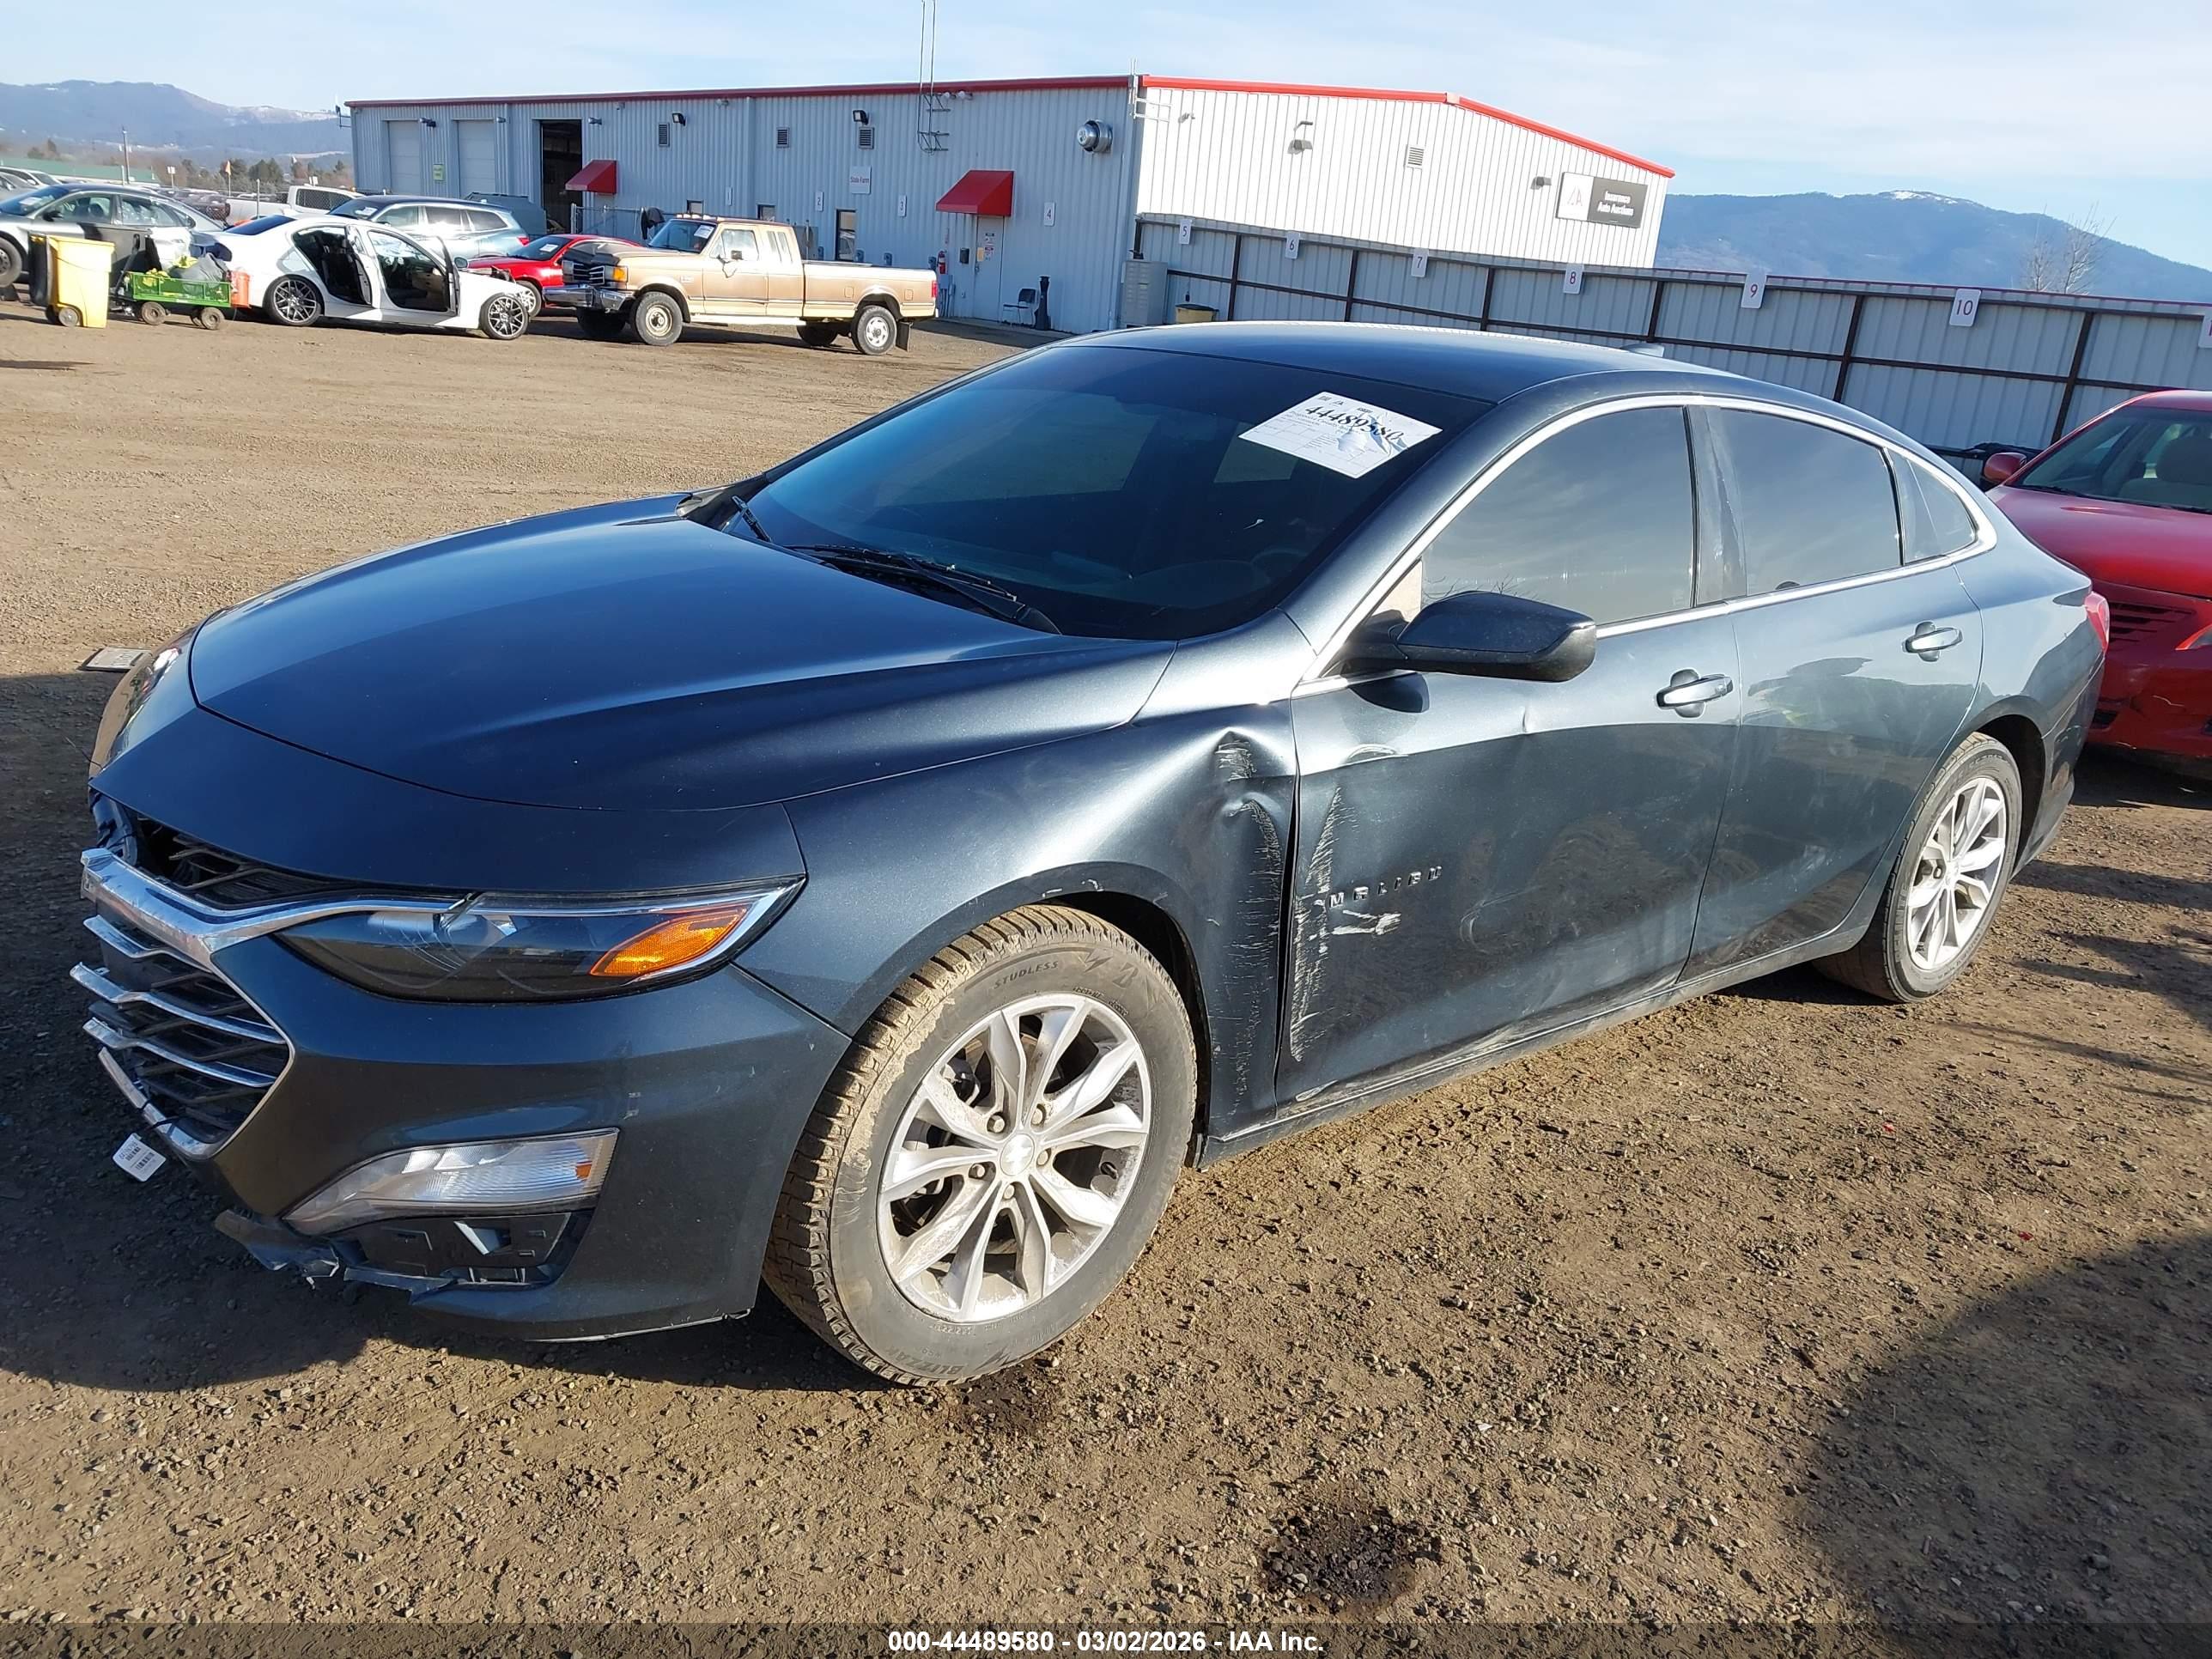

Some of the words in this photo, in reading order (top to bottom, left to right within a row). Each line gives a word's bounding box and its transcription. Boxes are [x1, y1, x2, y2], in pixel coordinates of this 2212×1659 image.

[899, 201, 904, 211] 3
[1046, 208, 1052, 220] 4
[1182, 226, 1188, 237] 5
[1289, 239, 1295, 251] 6
[1417, 256, 1423, 269] 7
[1569, 271, 1577, 284] 8
[1749, 283, 1759, 299] 9
[1955, 299, 1973, 316] 10
[1329, 866, 1443, 908] MALIBU
[993, 960, 1060, 990] STUDLESS
